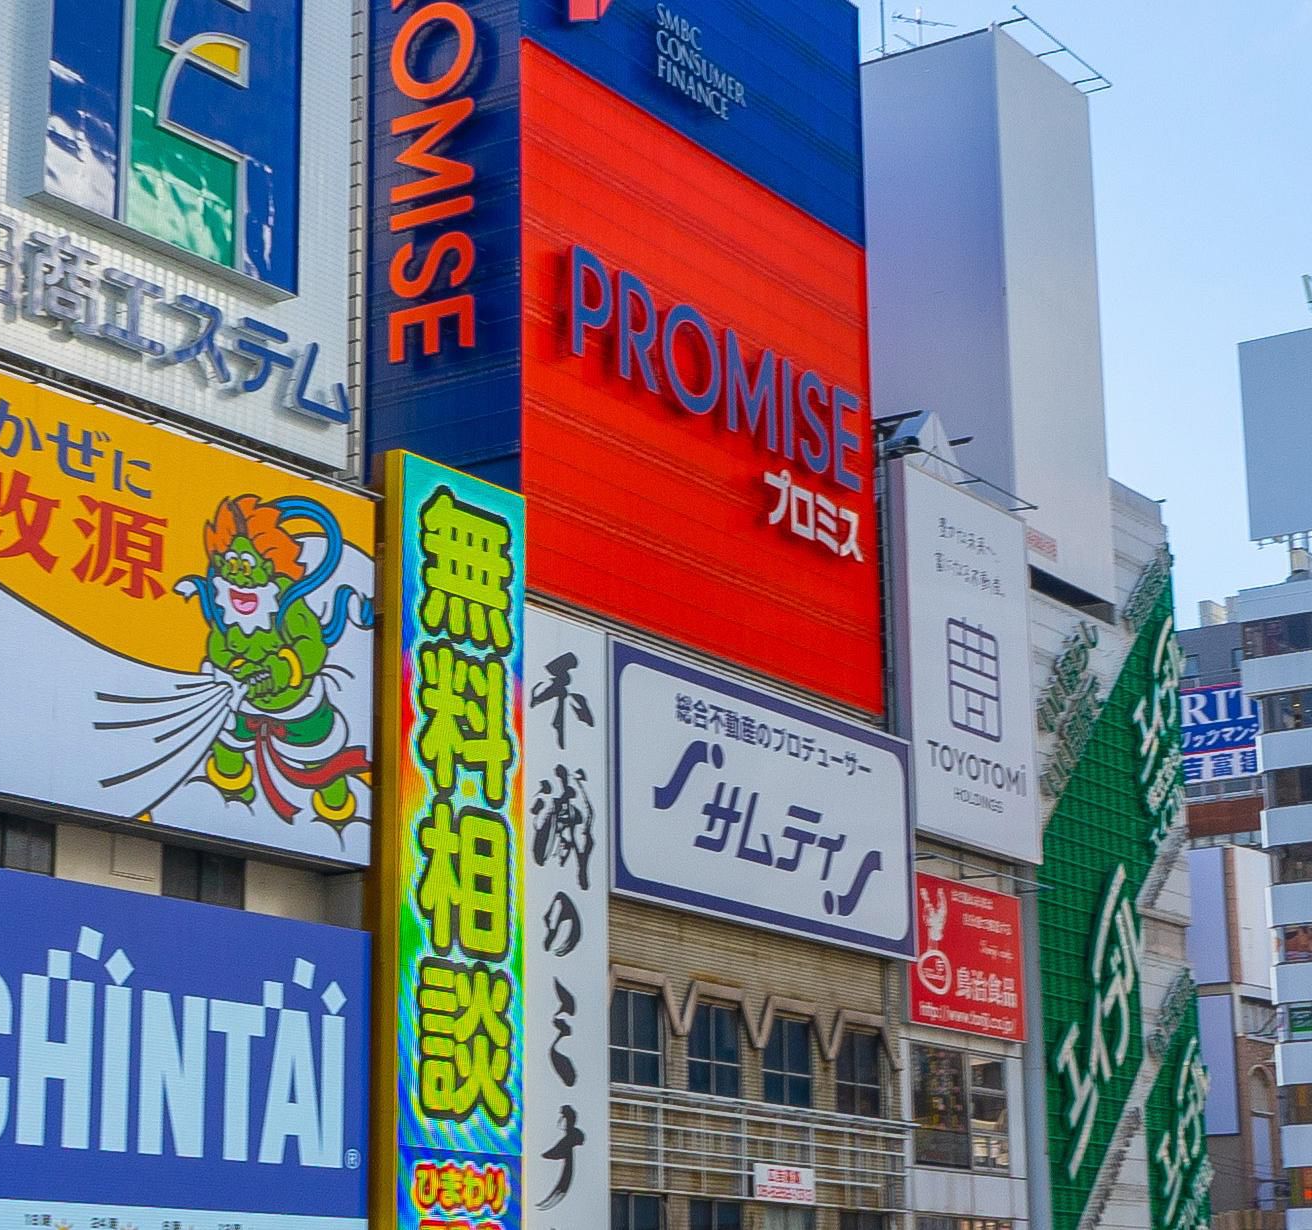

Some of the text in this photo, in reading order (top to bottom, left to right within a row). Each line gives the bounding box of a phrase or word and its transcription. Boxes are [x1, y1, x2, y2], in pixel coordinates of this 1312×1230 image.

[656, 3, 702, 51] SMBC
[656, 30, 748, 108] CONSUMER
[657, 55, 730, 121] FINANCE
[389, 0, 476, 366] OMISE
[570, 244, 863, 493] PROMISE
[763, 469, 864, 562] プロミス
[420, 485, 514, 1127] 無料相談
[530, 651, 596, 1230] 不滅のミナ
[414, 1160, 509, 1214] ひまわり
